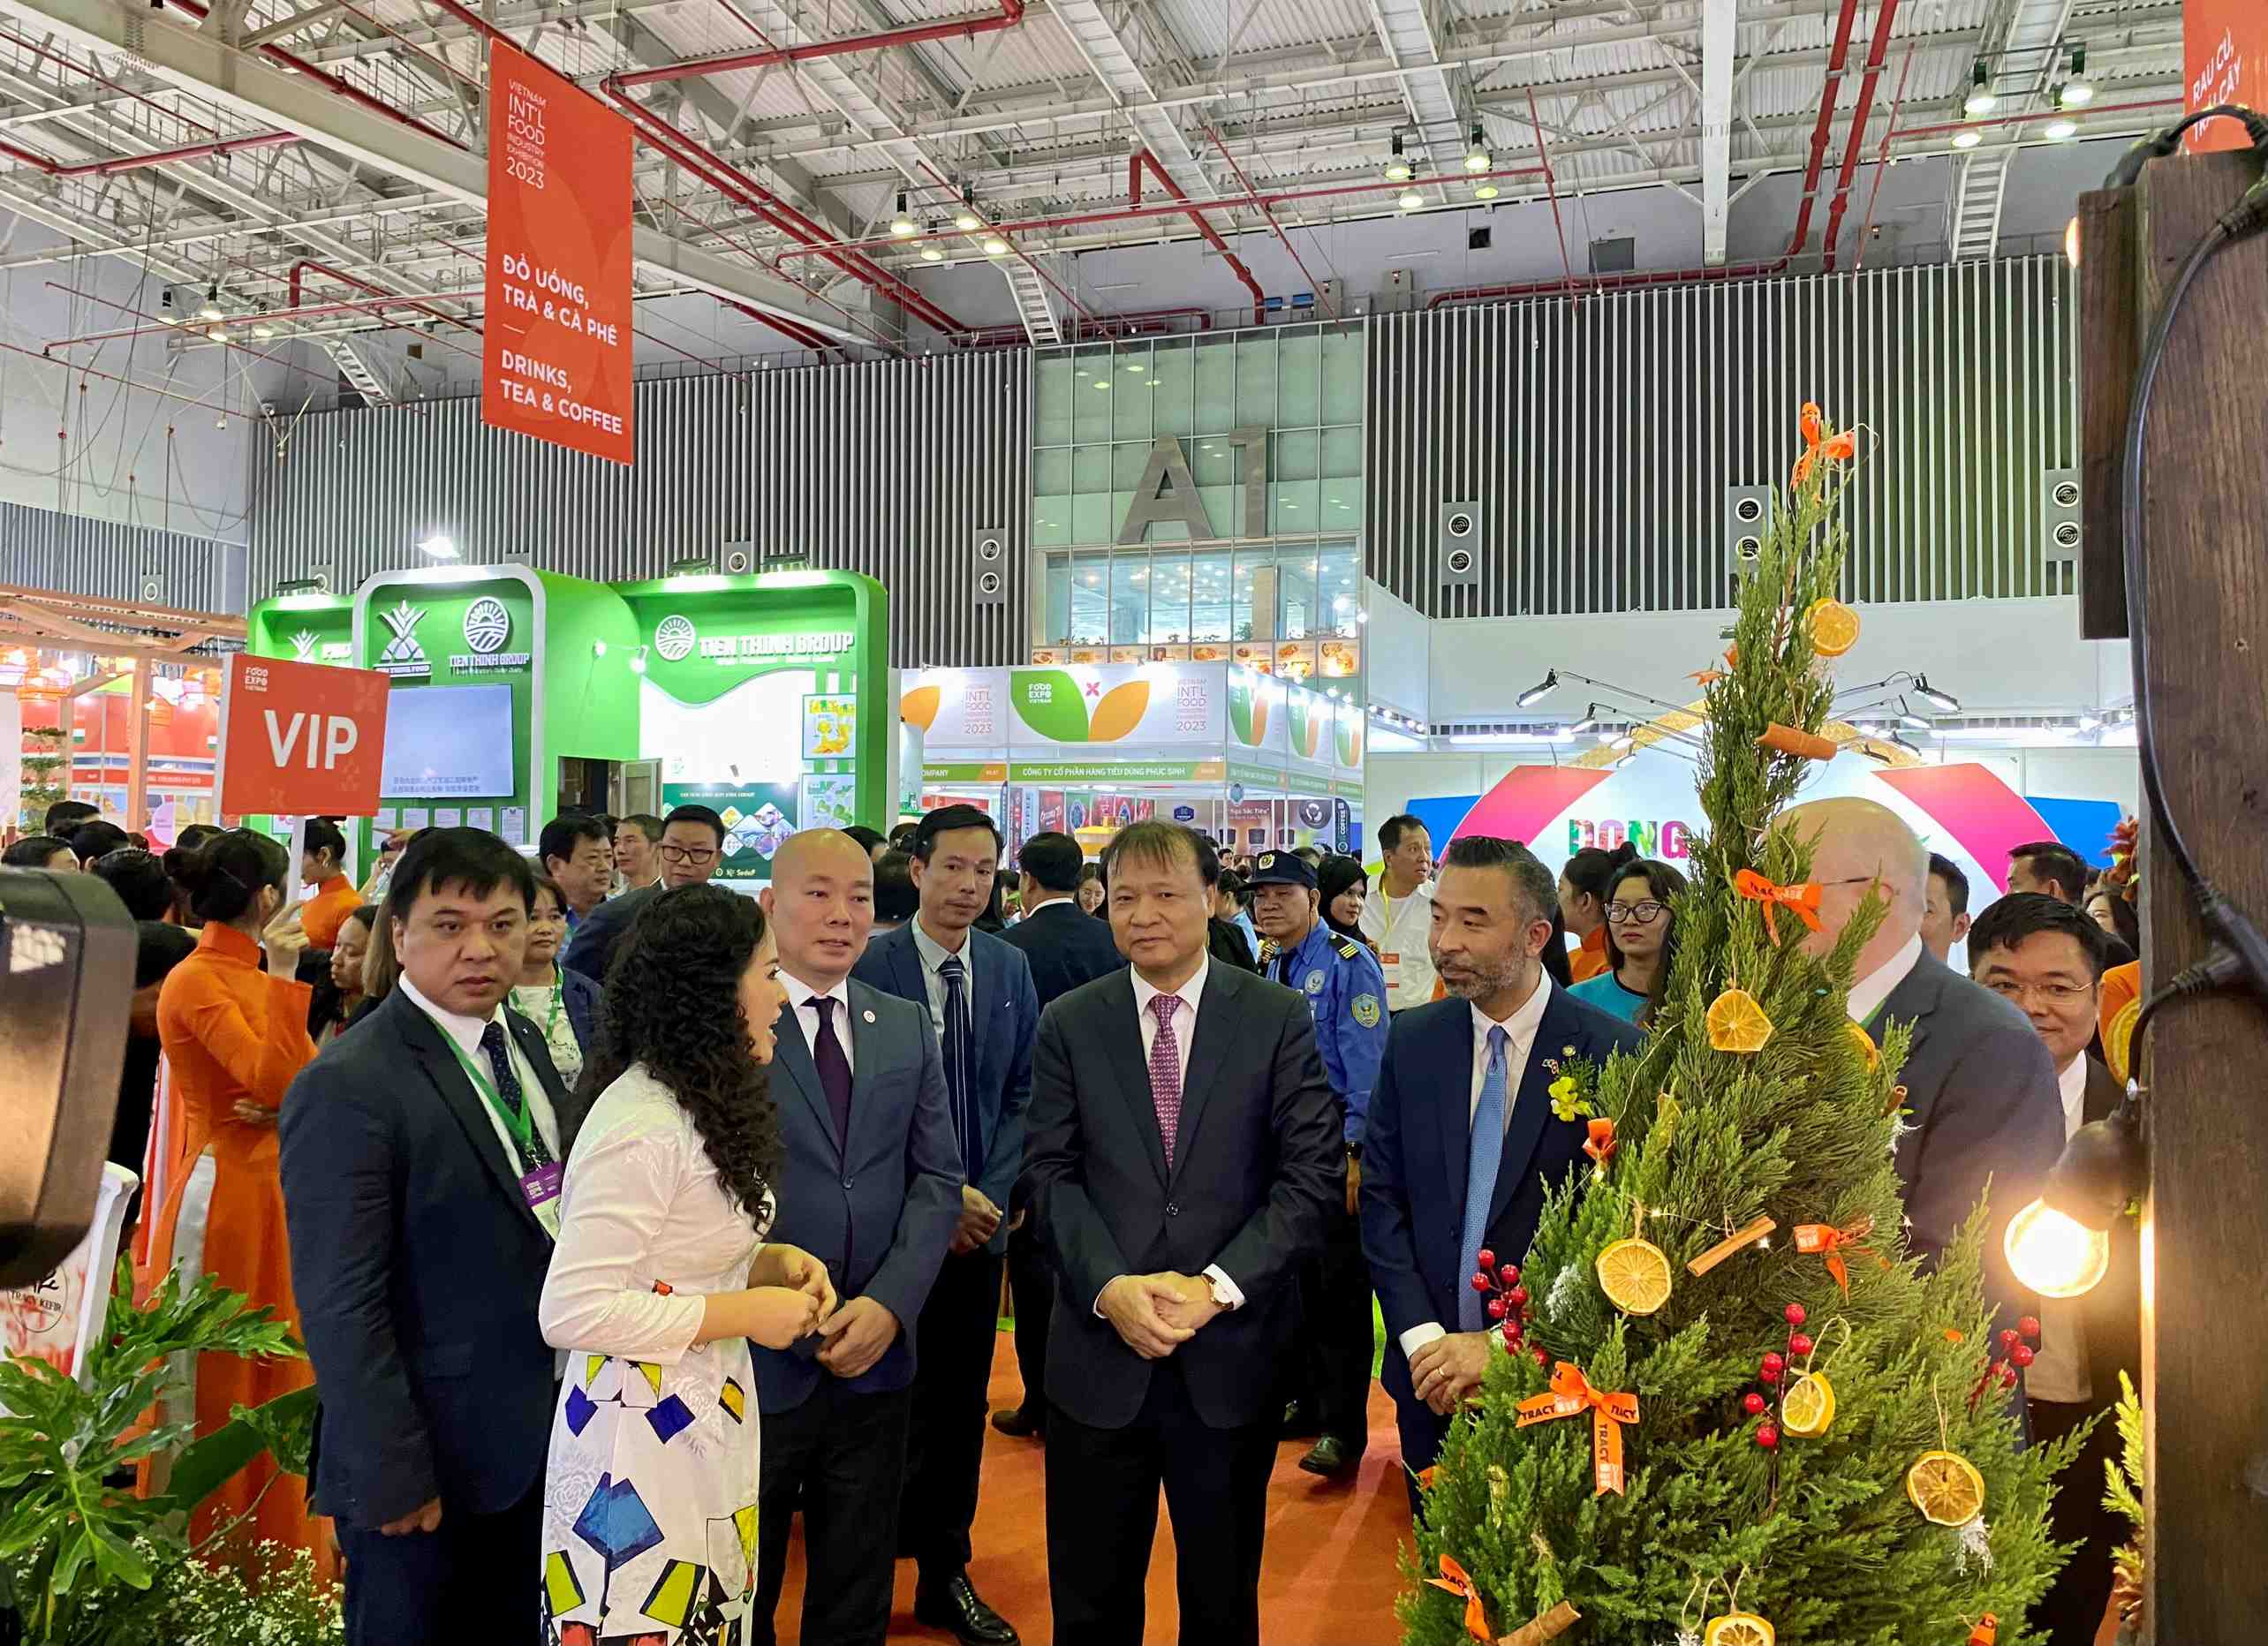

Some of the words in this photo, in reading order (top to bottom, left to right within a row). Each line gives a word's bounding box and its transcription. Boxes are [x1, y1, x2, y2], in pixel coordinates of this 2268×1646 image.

[509, 78, 547, 108] VIETNAM
[2193, 56, 2214, 106] RAU
[509, 93, 546, 130] INT'L
[508, 114, 545, 145] FOOD
[506, 155, 545, 189] 2023
[503, 253, 531, 281] ĐỒ
[535, 268, 589, 311] UỐNG,
[503, 283, 540, 315] TRÀ
[543, 300, 555, 321] &
[559, 307, 583, 333] CÀ
[586, 317, 617, 346] PHÊ
[501, 349, 572, 395] DRINKS,
[500, 379, 537, 407] TEA
[542, 393, 554, 412] &
[558, 397, 623, 434] COFFEE
[1116, 427, 1267, 545] A1
[796, 632, 855, 655] GROUP
[245, 676, 268, 686] EXPO
[246, 667, 268, 677] FOOD
[264, 709, 359, 769] VIP
[964, 723, 992, 735] 2023
[1176, 720, 1207, 732] 2023
[1043, 767, 1053, 776] TY
